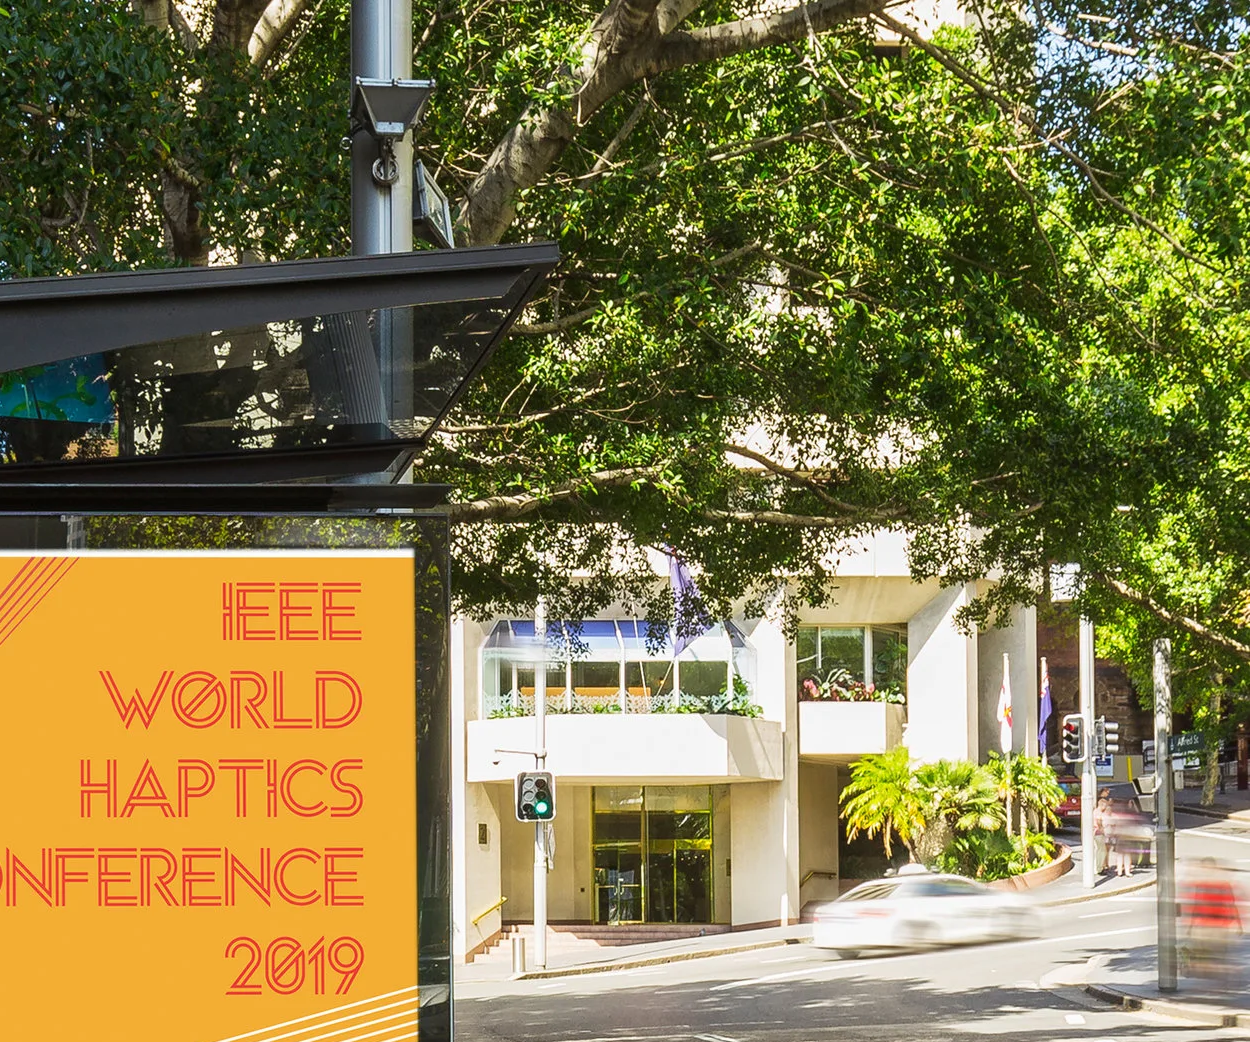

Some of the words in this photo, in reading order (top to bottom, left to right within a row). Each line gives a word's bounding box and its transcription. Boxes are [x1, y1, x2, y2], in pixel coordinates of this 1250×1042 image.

[222, 581, 362, 641] IEEE
[80, 758, 363, 818] HAPTICS
[225, 936, 364, 996] 2019
